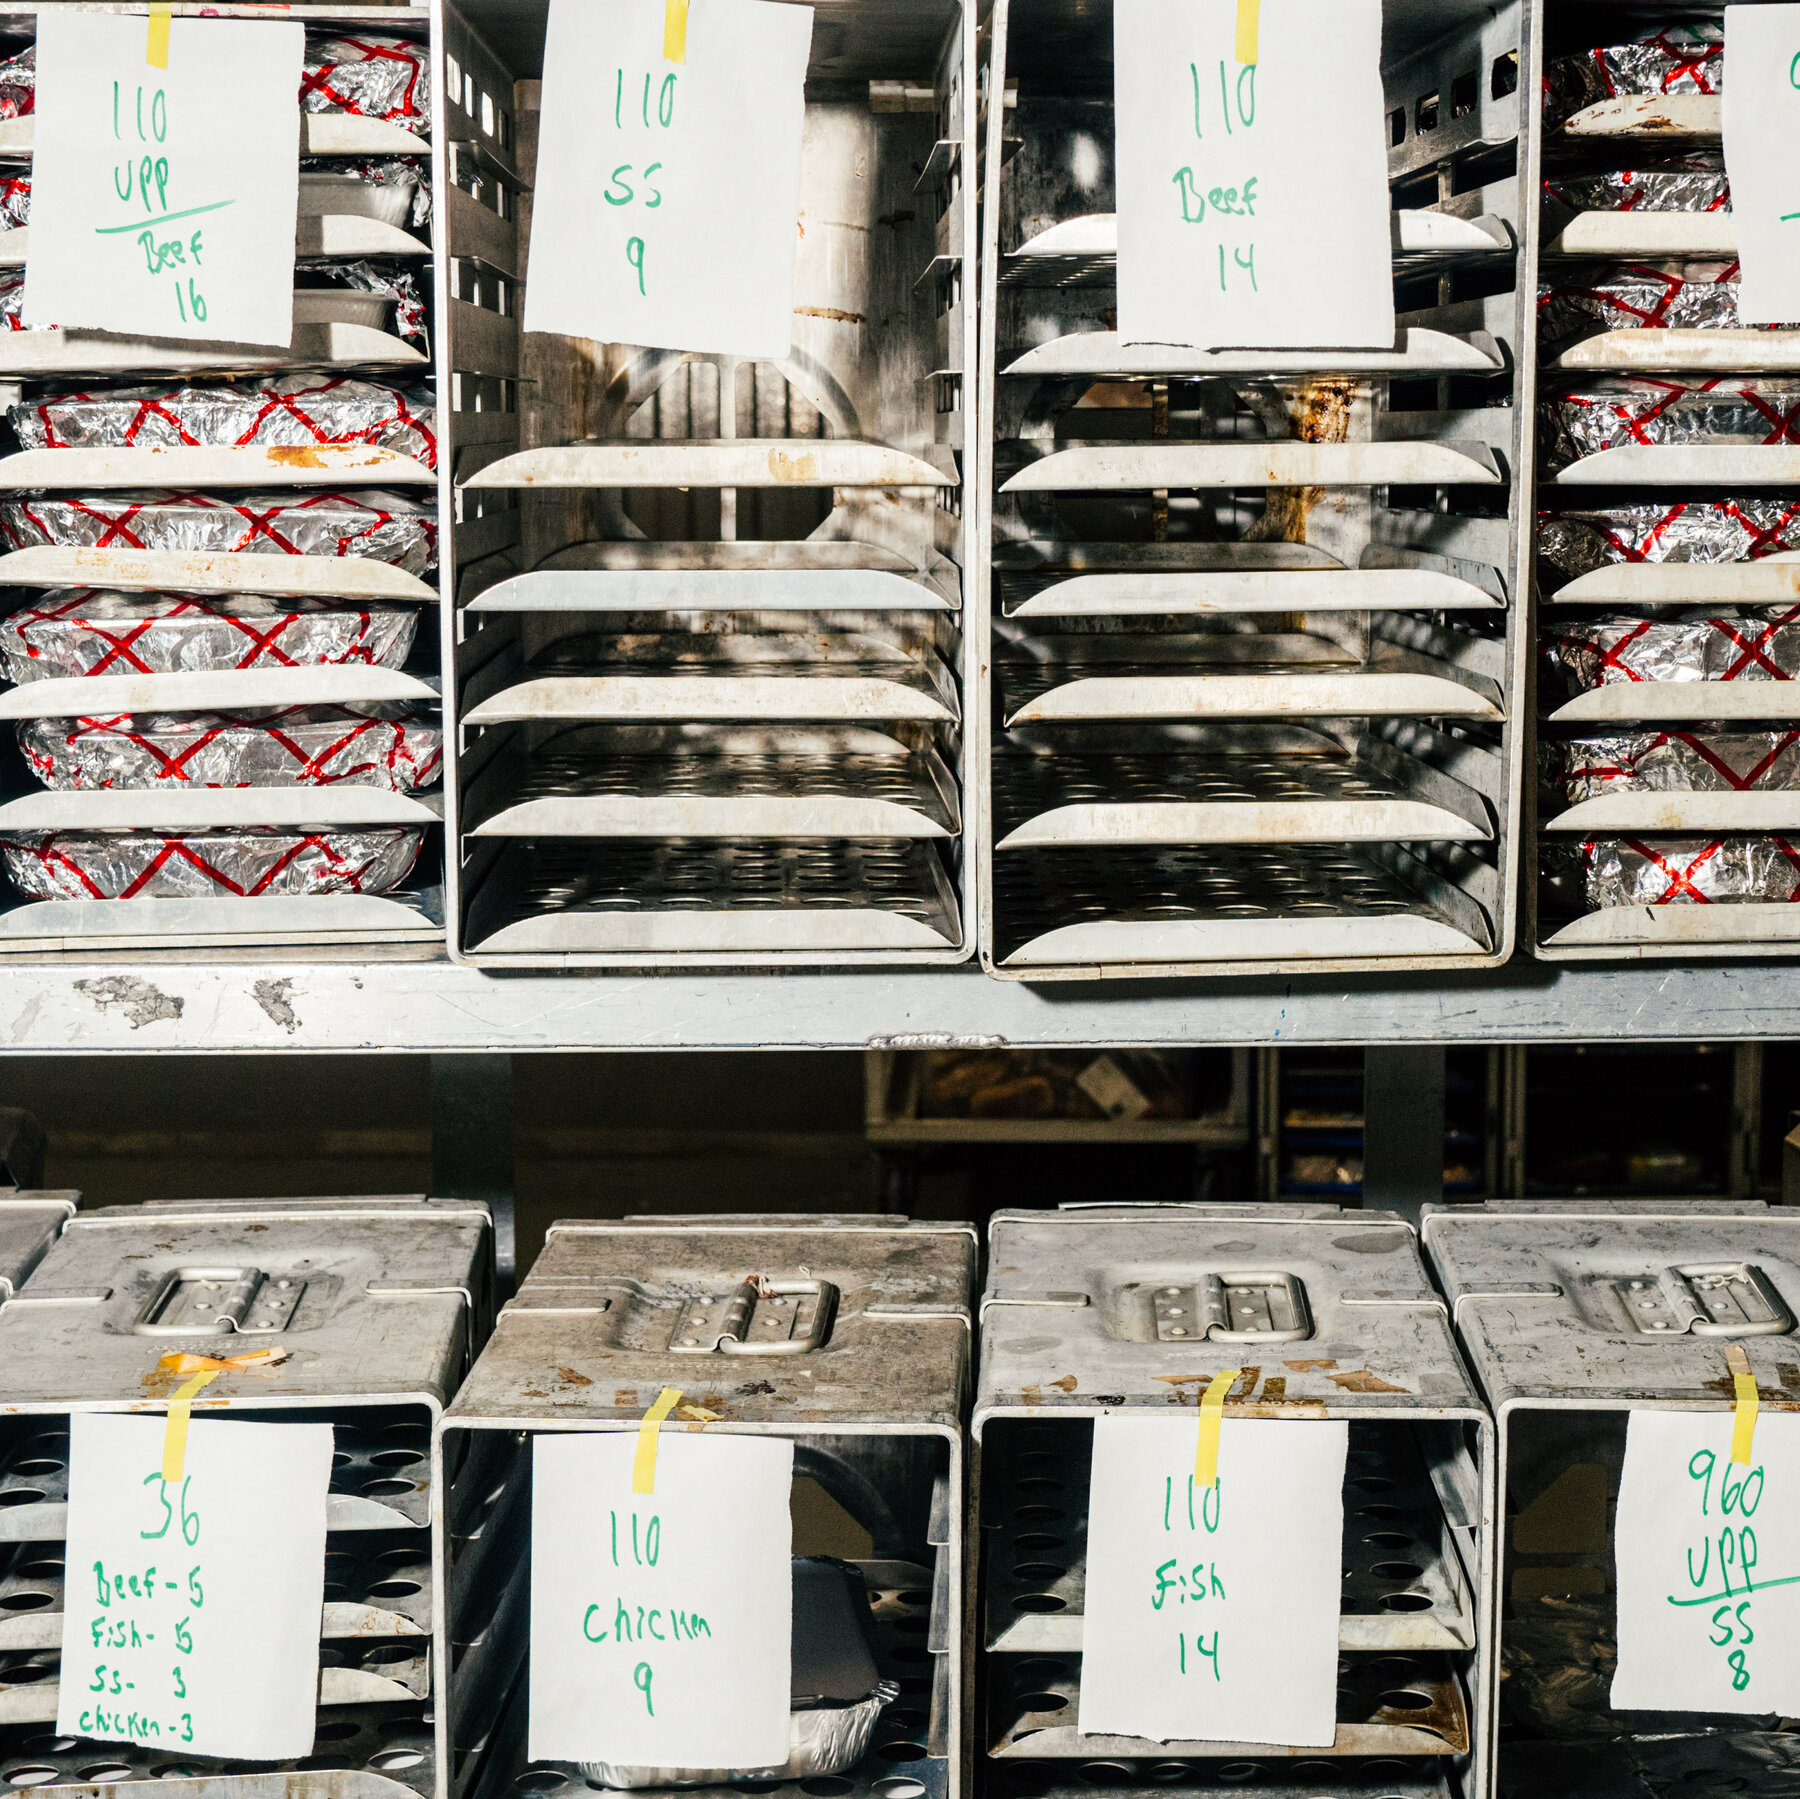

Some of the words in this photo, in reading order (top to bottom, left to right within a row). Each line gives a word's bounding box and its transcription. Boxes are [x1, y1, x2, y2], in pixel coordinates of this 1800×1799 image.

[113, 80, 167, 144] 110
[615, 68, 678, 129] 110
[1190, 59, 1257, 139] 110
[1171, 165, 1259, 224] Beef
[137, 229, 204, 275] Beef
[626, 236, 647, 297] 9
[1218, 243, 1258, 292] 14
[175, 277, 208, 324] 16
[139, 1471, 200, 1547] 36
[1164, 1473, 1221, 1535] 110
[1688, 1448, 1765, 1519] 960
[610, 1510, 661, 1568] 110
[1179, 1631, 1221, 1683] 14
[1727, 1648, 1751, 1692] 8
[633, 1661, 655, 1717] 9
